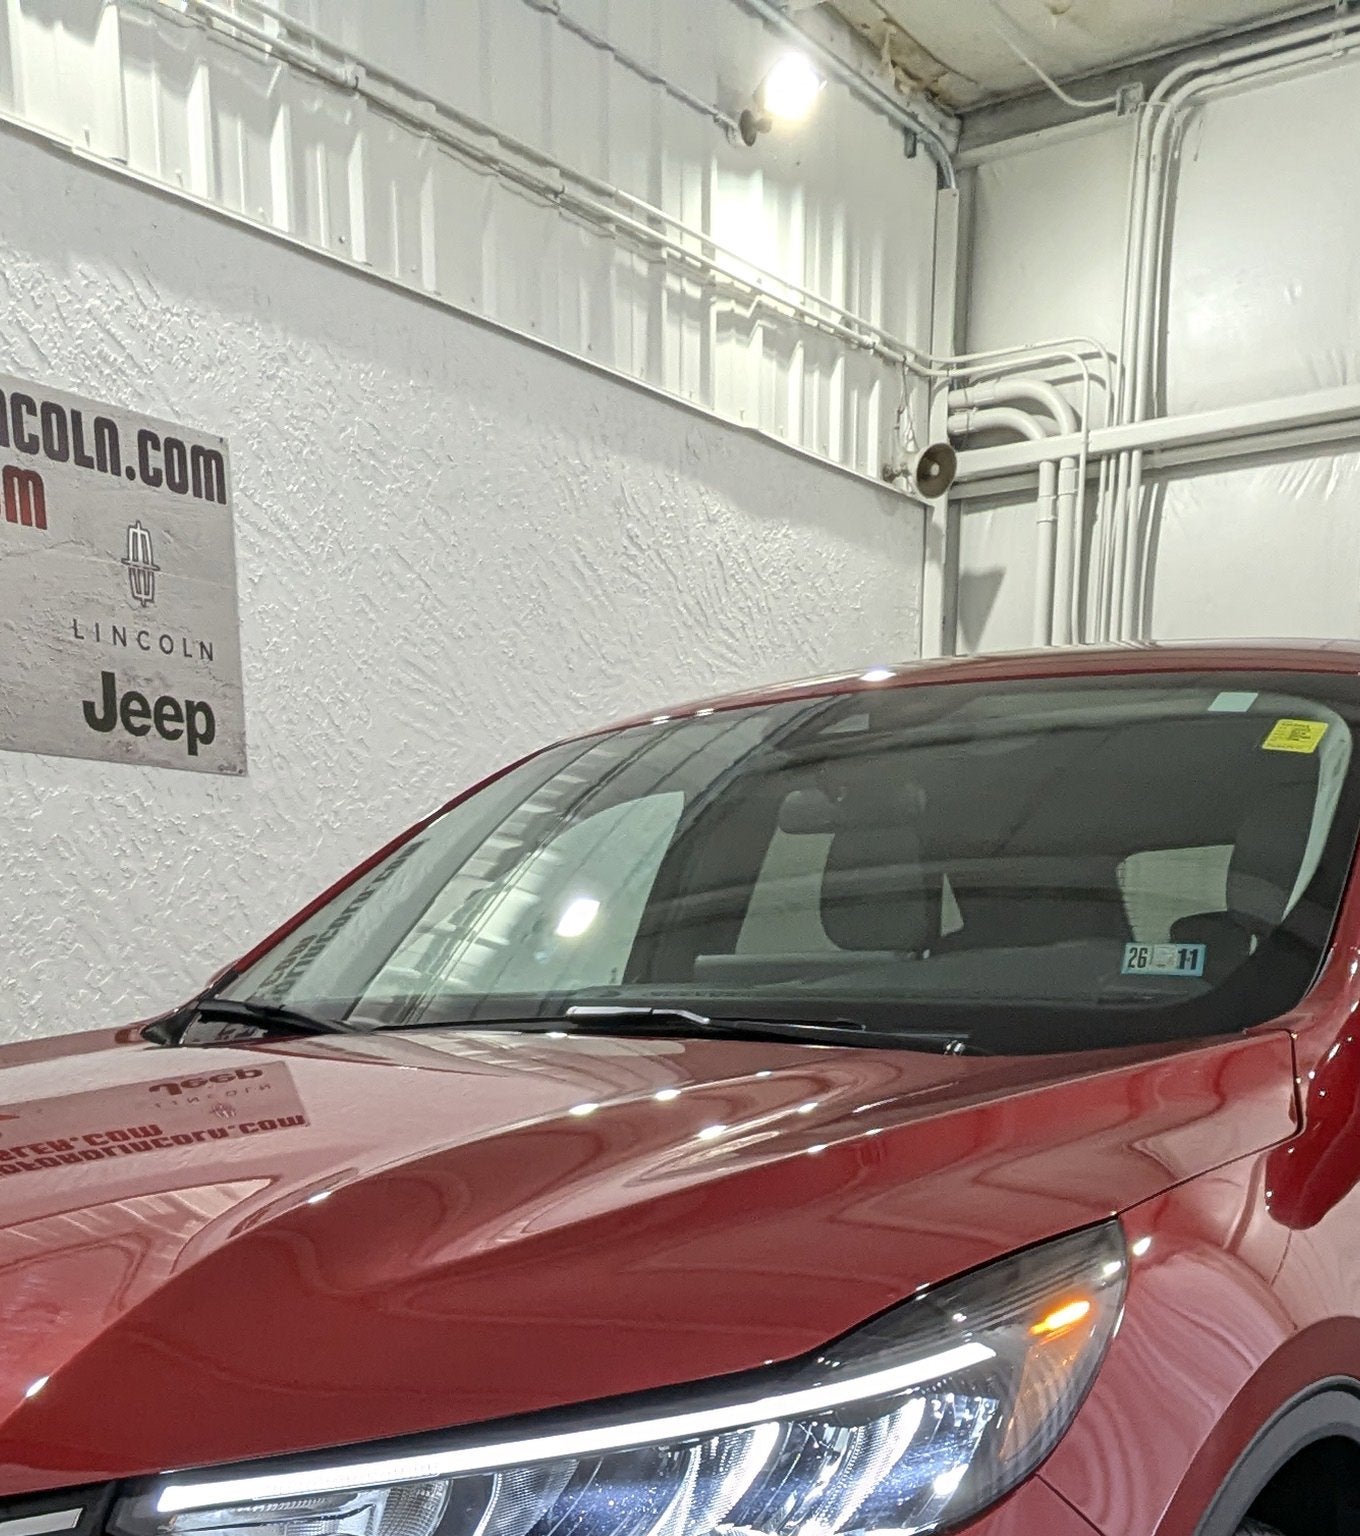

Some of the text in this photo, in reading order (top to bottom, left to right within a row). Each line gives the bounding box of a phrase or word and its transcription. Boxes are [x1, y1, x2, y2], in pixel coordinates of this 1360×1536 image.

[71, 617, 215, 663] LINCOLN
[82, 671, 217, 756] Jeep
[1127, 947, 1198, 970] 26 11
